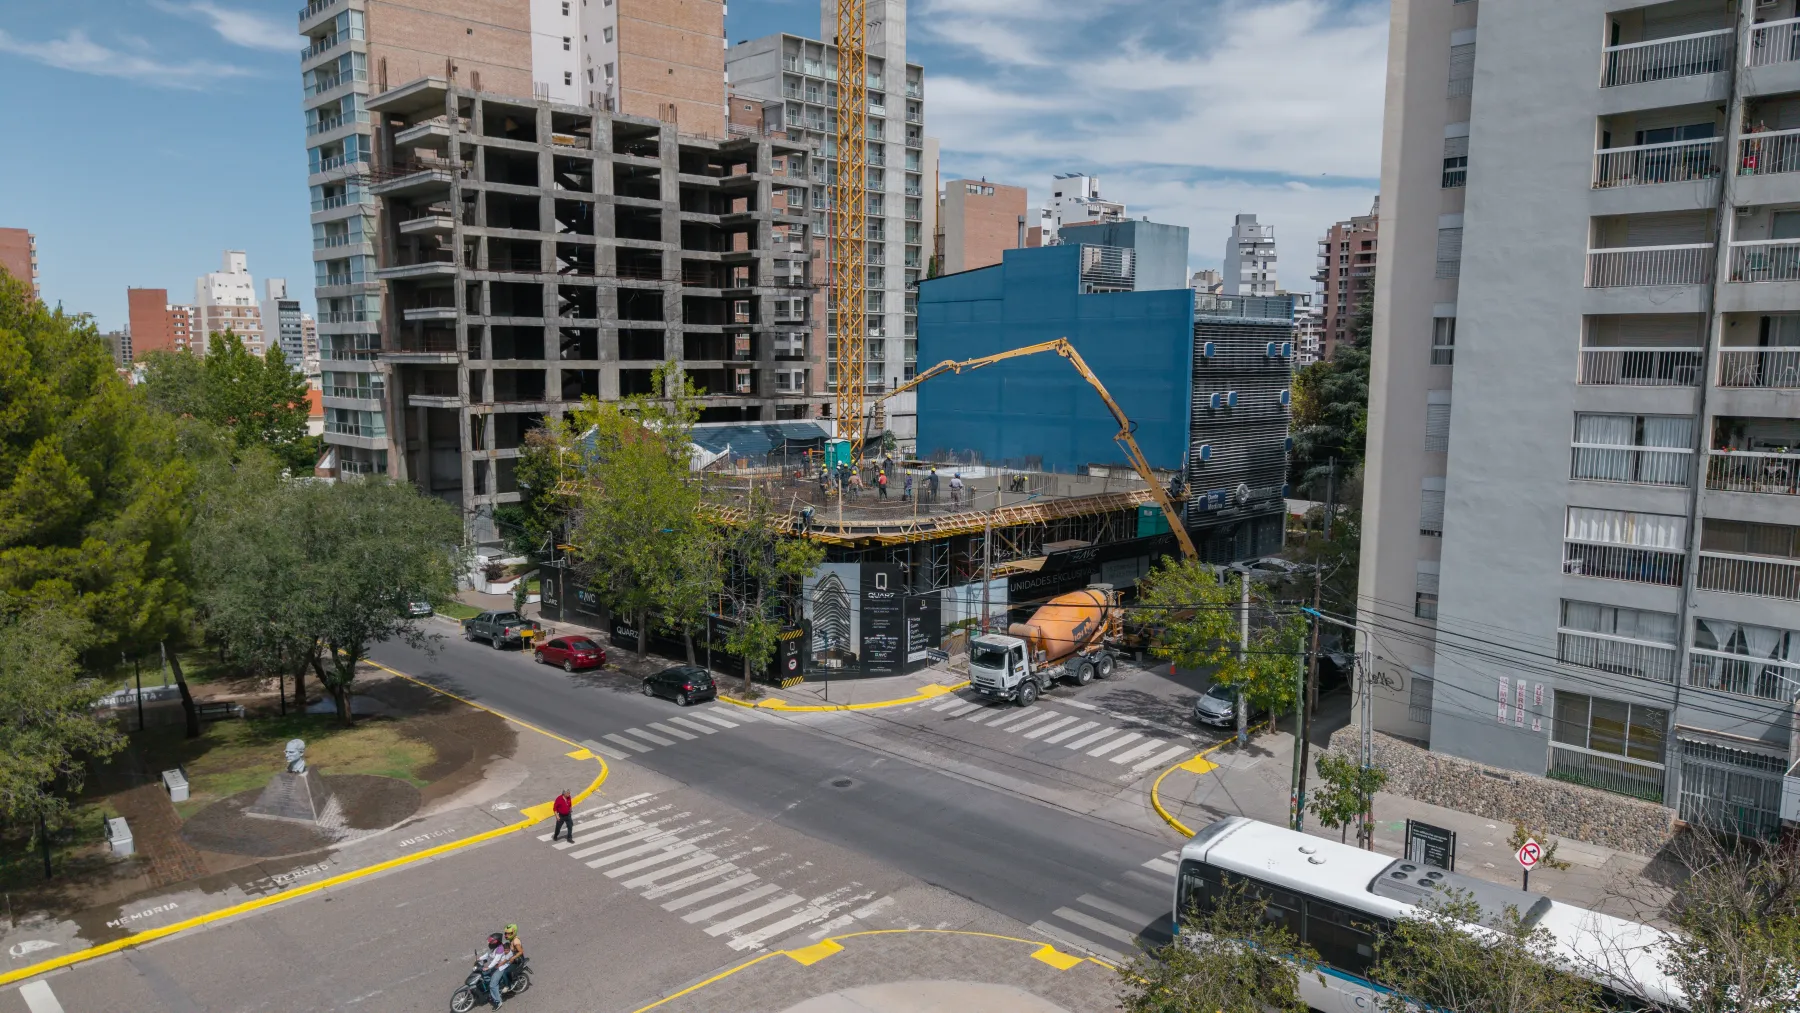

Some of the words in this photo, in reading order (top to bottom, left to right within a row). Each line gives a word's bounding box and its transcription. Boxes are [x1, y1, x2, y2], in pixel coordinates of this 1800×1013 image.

[1010, 575, 1052, 592] UNIDADES
[616, 625, 639, 639] QUARZ
[1499, 677, 1508, 722] MEMORIA
[1516, 684, 1525, 723] VERDAD
[398, 827, 456, 848] JUSTICIA
[272, 864, 329, 884] VERDAD
[105, 901, 180, 928] MEMORIA
